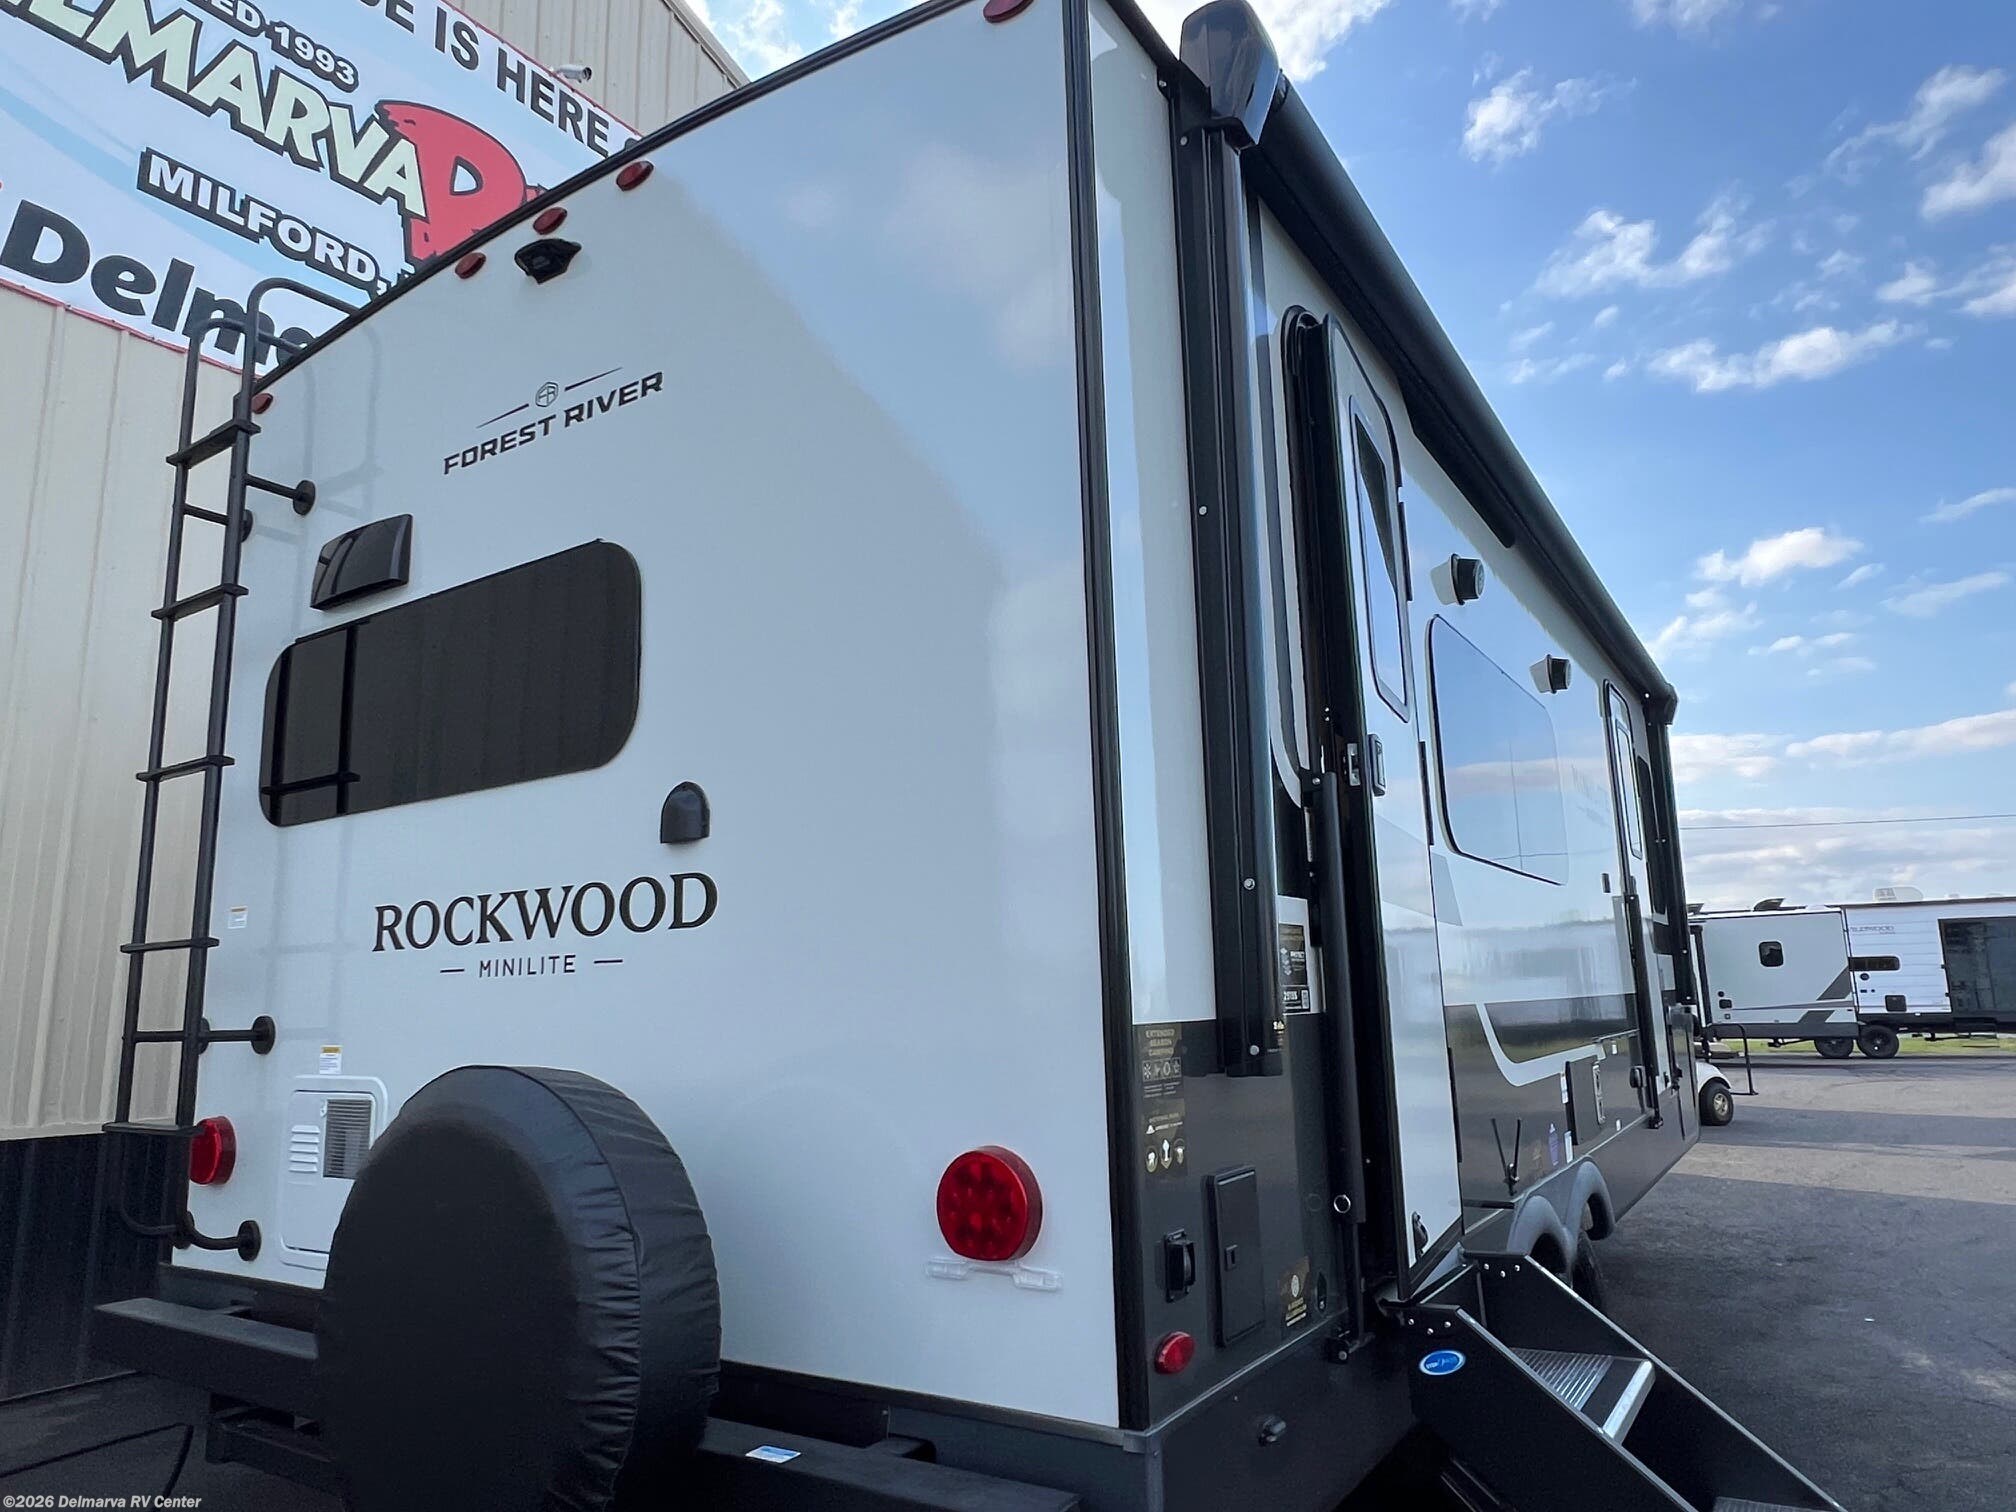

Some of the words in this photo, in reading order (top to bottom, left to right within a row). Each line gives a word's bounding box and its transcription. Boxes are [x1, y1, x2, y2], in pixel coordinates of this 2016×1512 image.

[274, 26, 354, 85] 1993
[360, 0, 414, 33] E
[434, 6, 480, 71] IS
[497, 47, 609, 158] HERE
[0, 0, 426, 218] MARVA
[443, 414, 557, 475] FOREST
[564, 371, 663, 428] RIVER
[372, 871, 719, 952] ROCKWOOD
[479, 954, 577, 978] MINILITE
